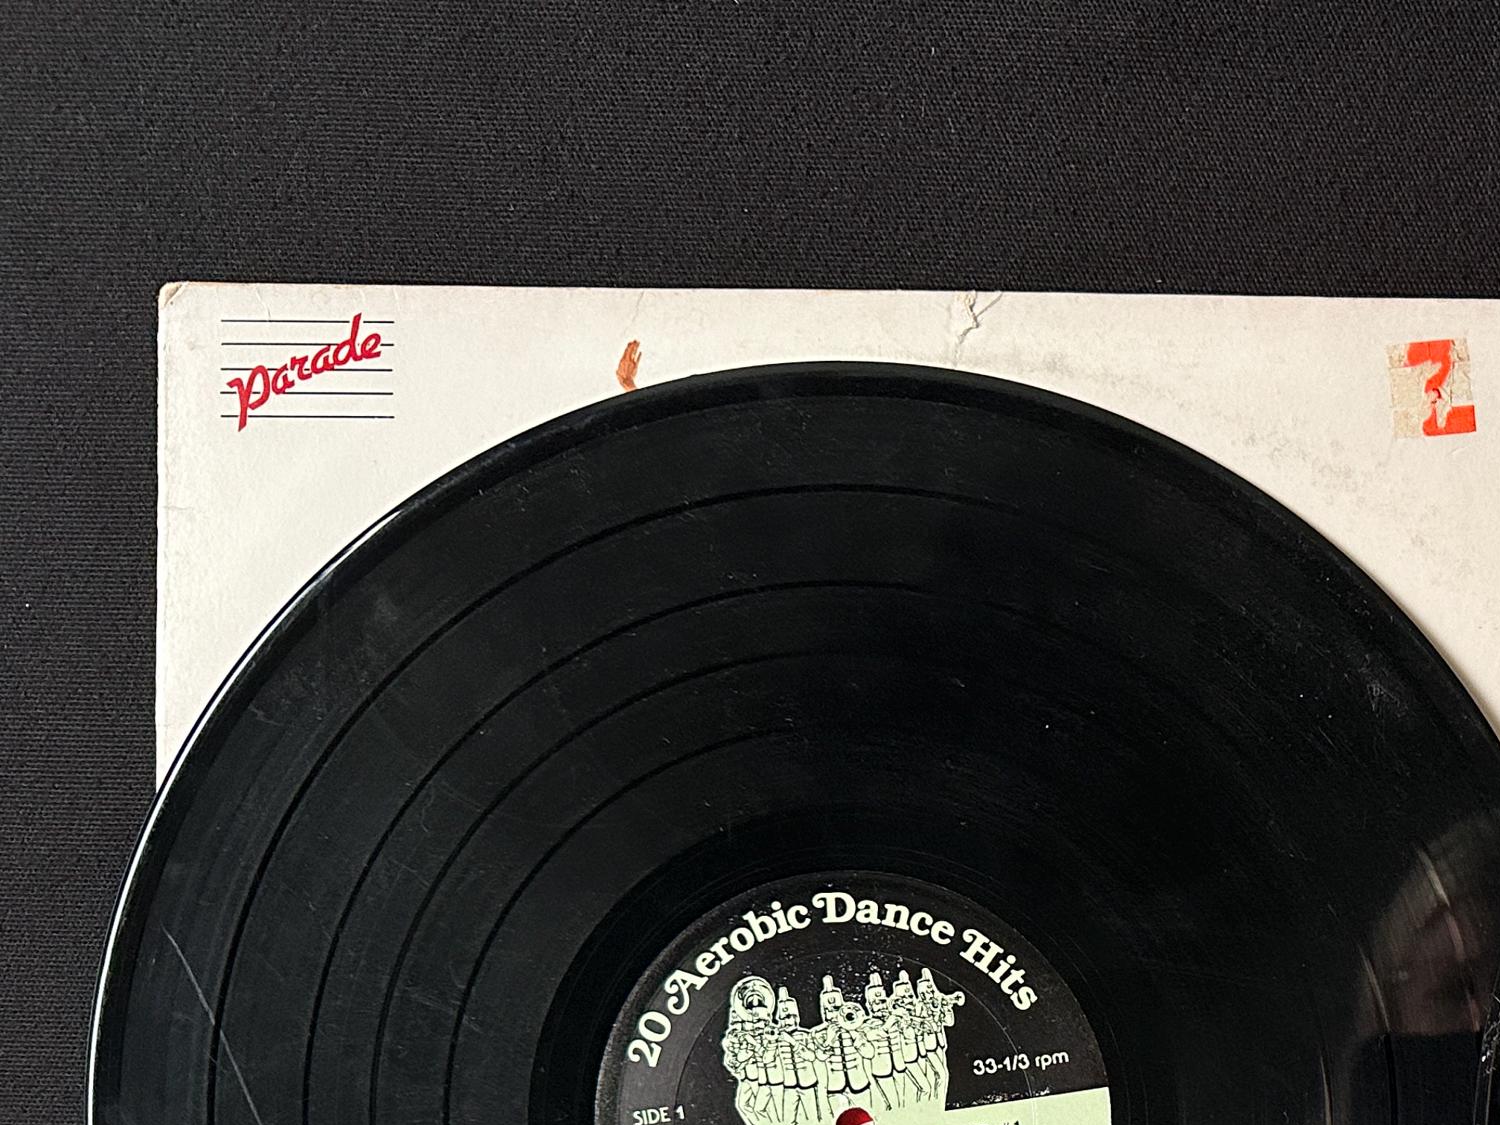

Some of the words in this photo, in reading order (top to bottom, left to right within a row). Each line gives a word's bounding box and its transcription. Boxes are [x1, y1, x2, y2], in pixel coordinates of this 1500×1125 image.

[628, 1011, 673, 1068] 20
[664, 901, 813, 1016] Aerobic
[812, 892, 956, 945] Dance
[960, 930, 1038, 1011] Hits
[973, 1053, 1030, 1075] 33-1/3
[1035, 1051, 1069, 1071] rpm
[676, 1105, 686, 1120] 1
